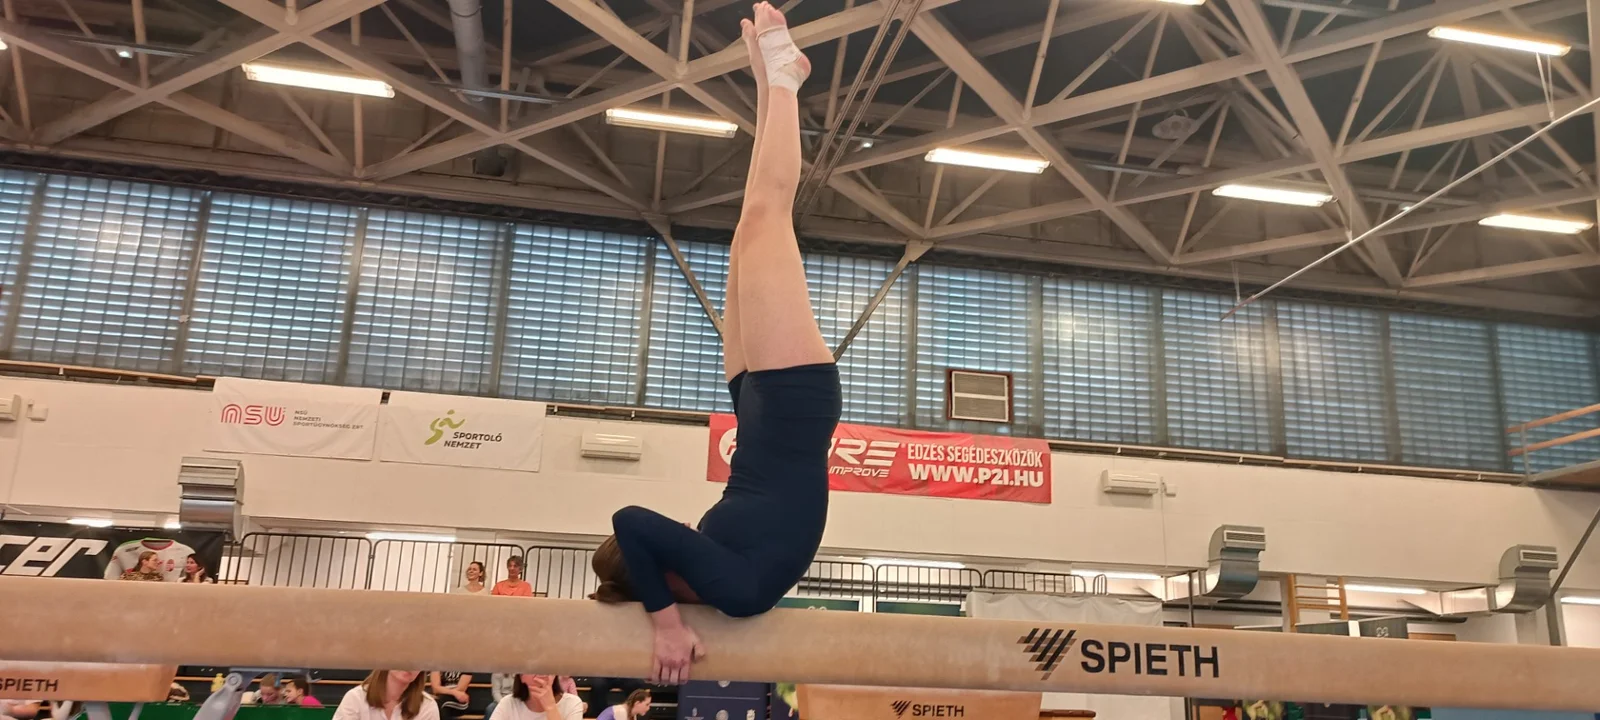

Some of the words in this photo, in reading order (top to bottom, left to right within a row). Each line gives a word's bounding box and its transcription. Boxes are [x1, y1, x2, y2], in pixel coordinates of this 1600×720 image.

[453, 431, 502, 443] SPORTOLÓ
[444, 440, 482, 450] NEMZET
[907, 443, 945, 461] EDZÉS
[947, 444, 1043, 468] SEGÉDESZKÖZÖK
[828, 465, 890, 478] IMPROVE
[908, 463, 1044, 487] WWW.P2I.HU
[1080, 639, 1220, 678] SPIETH
[912, 704, 965, 717] SPIETH
